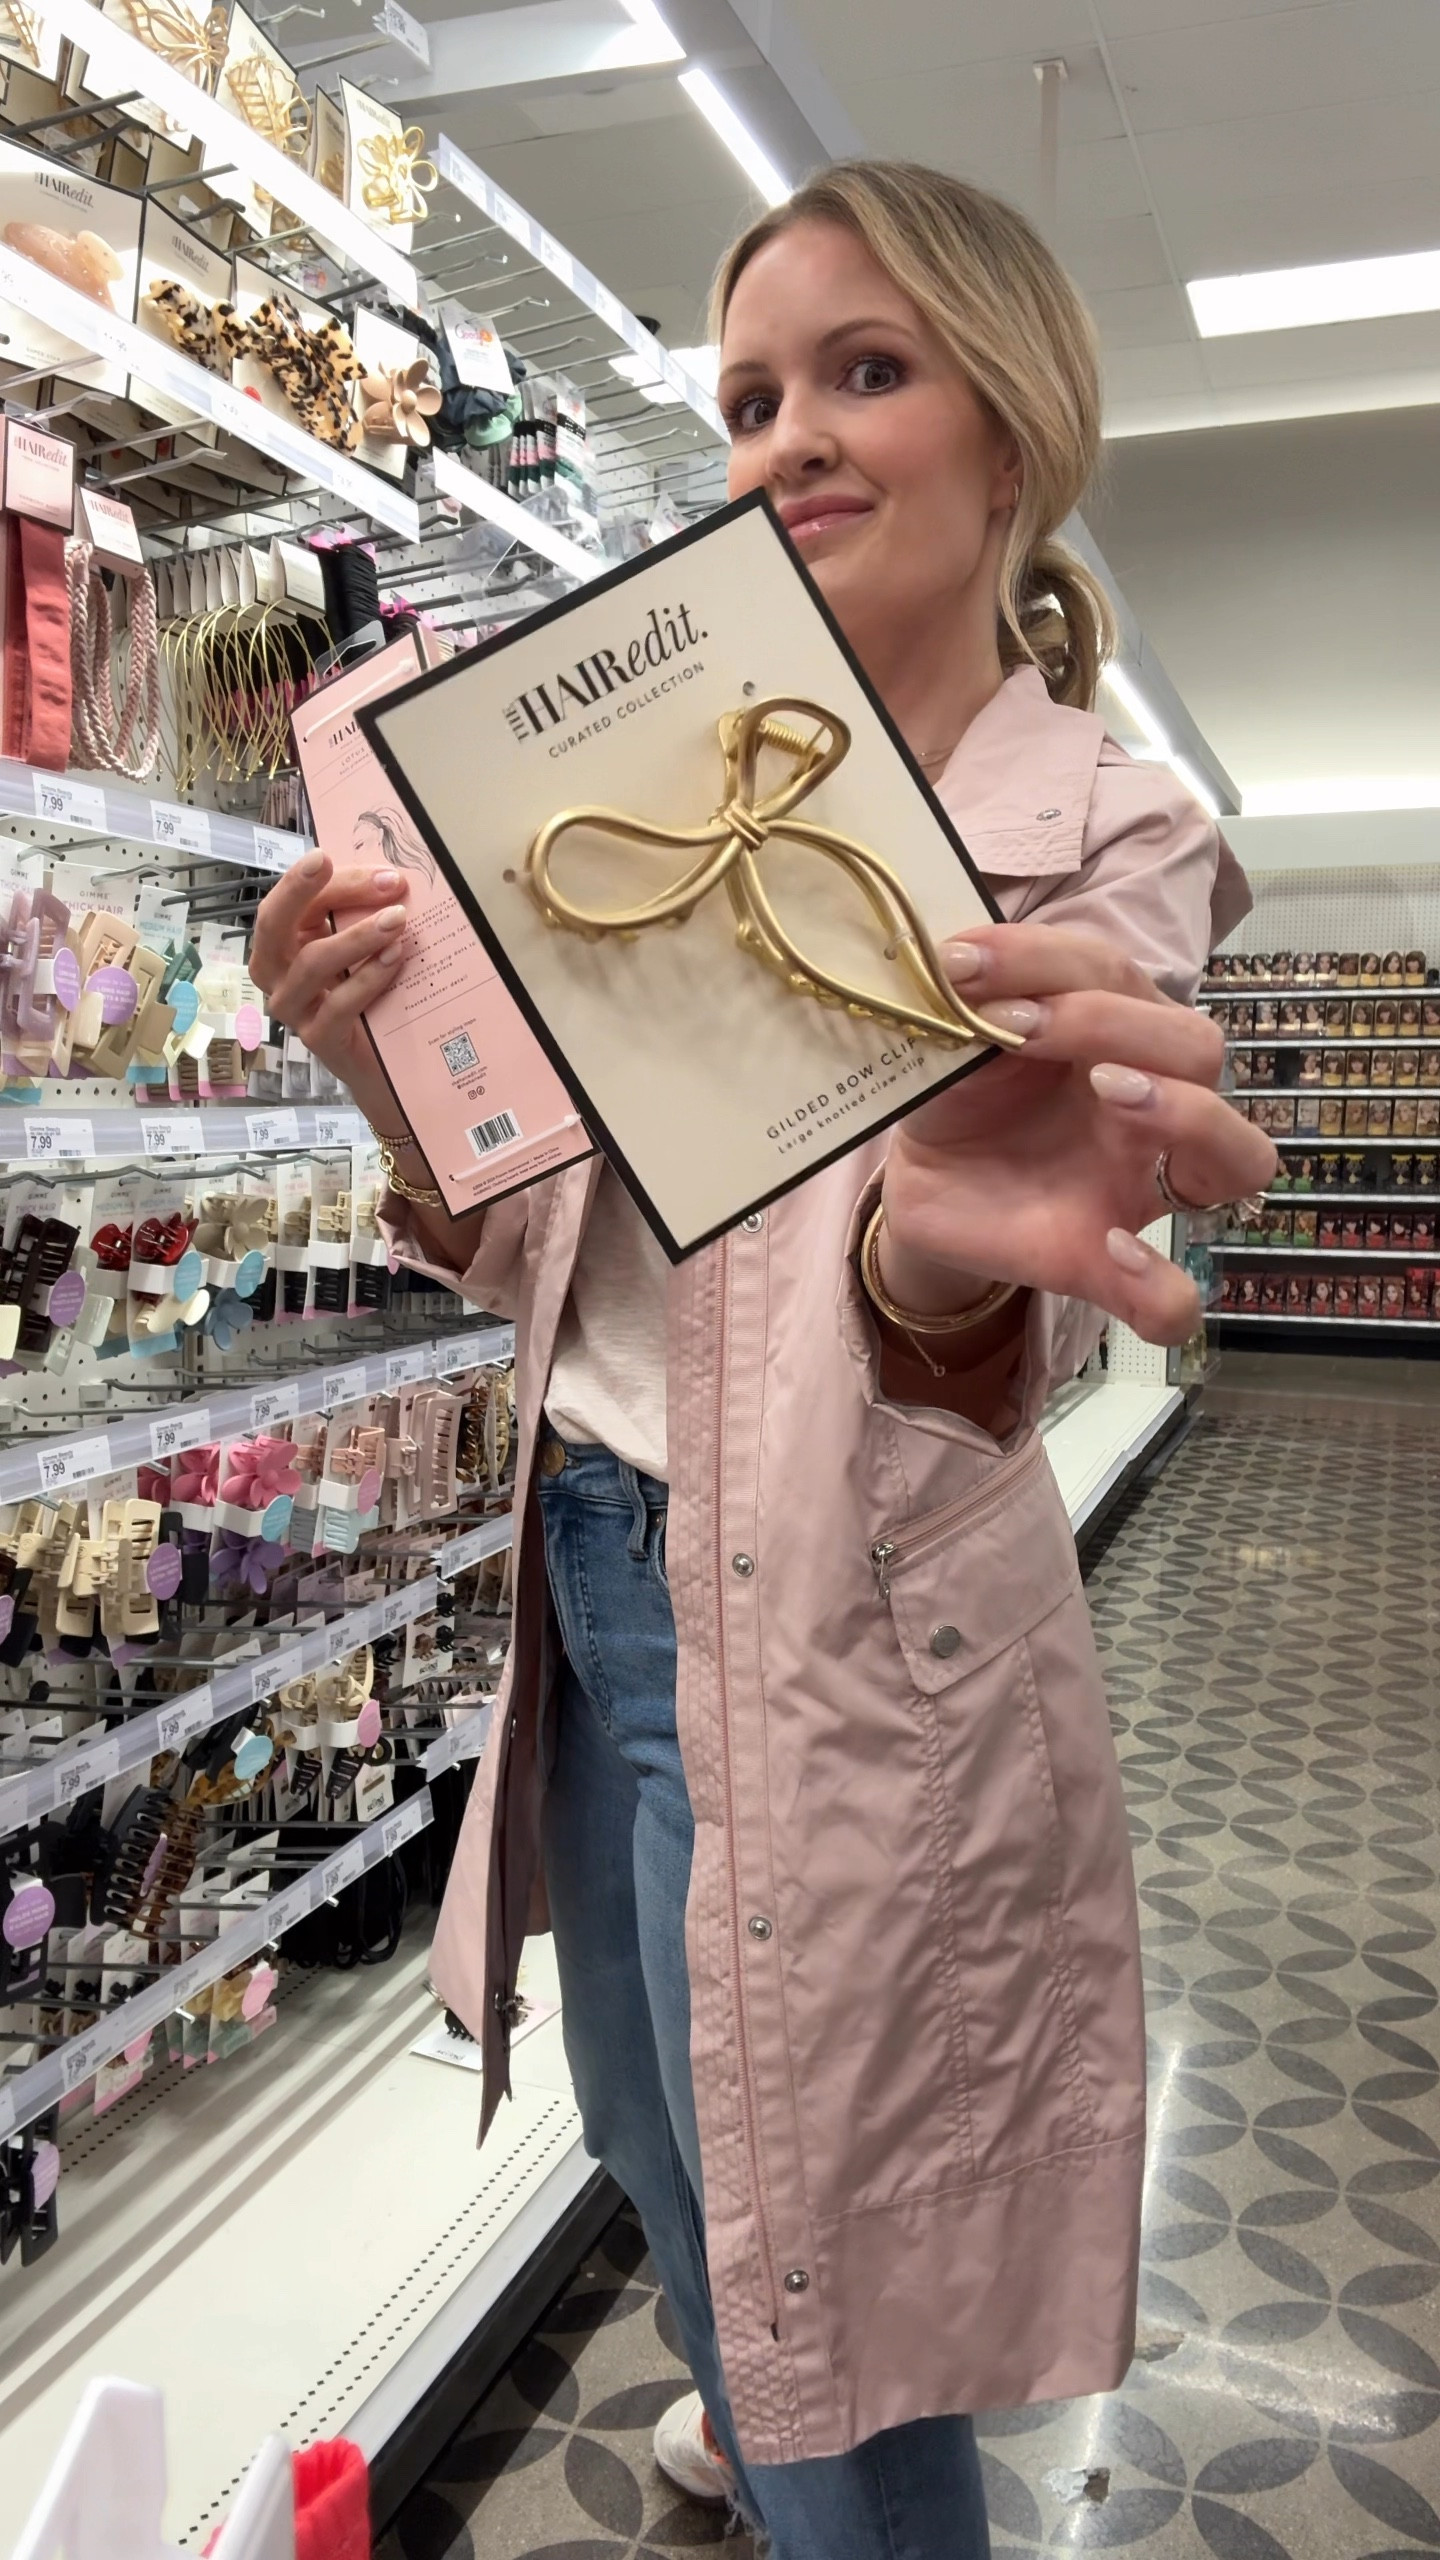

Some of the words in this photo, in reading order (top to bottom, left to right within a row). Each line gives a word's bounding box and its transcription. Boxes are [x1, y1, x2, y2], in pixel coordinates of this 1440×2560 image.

[549, 716, 612, 758] CURATED
[617, 661, 704, 720] COLLECTION
[42, 794, 64, 812] 7.99
[156, 819, 174, 836] 7.99
[258, 845, 273, 860] 7.99
[79, 890, 109, 900] GIMME
[98, 903, 124, 915] HAIR
[415, 910, 443, 928] headband
[433, 931, 456, 947] wicking
[404, 996, 428, 1011] Pleated
[429, 986, 448, 999] center
[450, 974, 468, 987] detail
[766, 1093, 830, 1140] GILDED
[836, 1064, 874, 1095] BOW
[880, 1036, 916, 1066] CLIP
[777, 1128, 814, 1154] Large
[816, 1093, 866, 1129] knotted
[870, 1074, 898, 1095] claw
[901, 1056, 925, 1075] clip
[30, 1135, 52, 1149] 7.99
[146, 1134, 166, 1146] 7.99
[253, 1128, 269, 1142] 7.99
[319, 1128, 334, 1140] 7.99
[255, 1404, 271, 1421] 7.99
[157, 1432, 176, 1447] 7.99
[43, 1462, 66, 1480] 7.99
[254, 1677, 271, 1696] 7.99
[162, 1721, 180, 1741] 7.99
